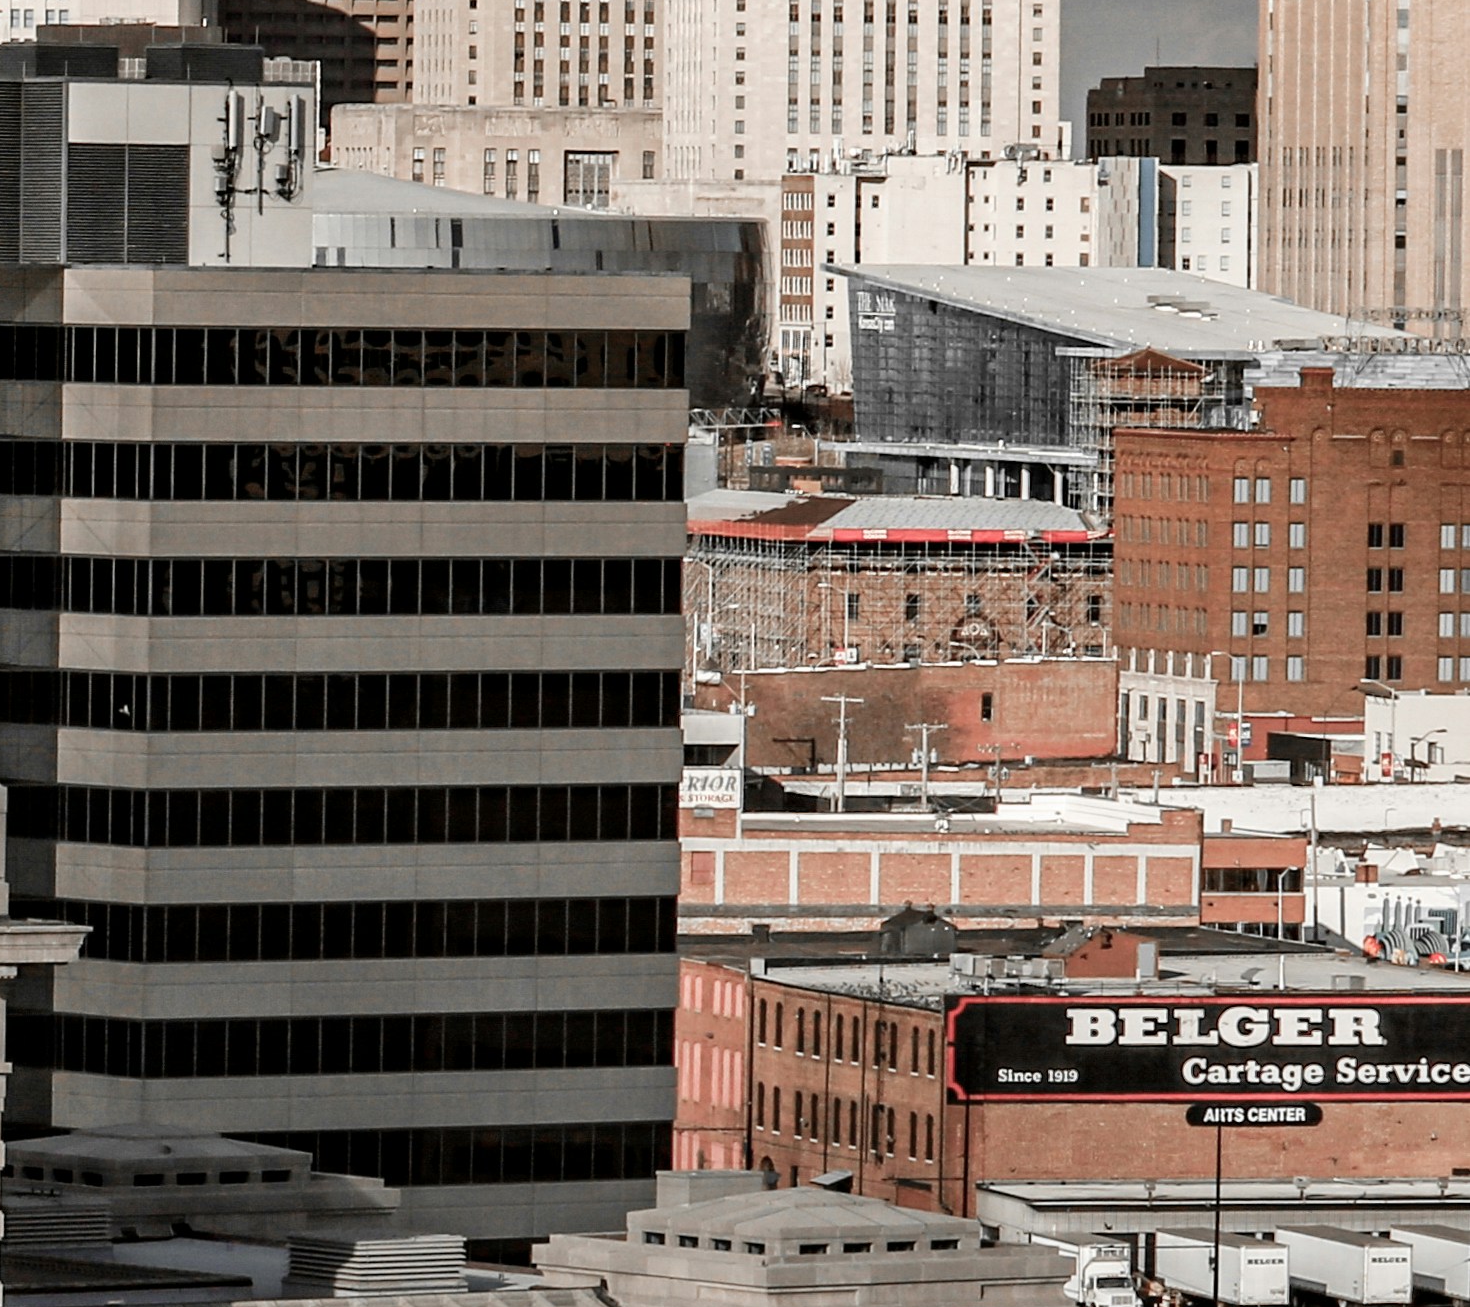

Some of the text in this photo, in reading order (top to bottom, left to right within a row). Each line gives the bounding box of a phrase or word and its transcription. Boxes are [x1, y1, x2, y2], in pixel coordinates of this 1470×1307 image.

[679, 775, 737, 792] RIOR
[688, 794, 735, 802] STORAGE
[1065, 1006, 1385, 1047] BELGER
[997, 1067, 1079, 1083] Since 1919
[1182, 1057, 1325, 1091] Cartage
[1203, 1106, 1306, 1123] ARTS CENTER
[1371, 1256, 1408, 1264] BELGER
